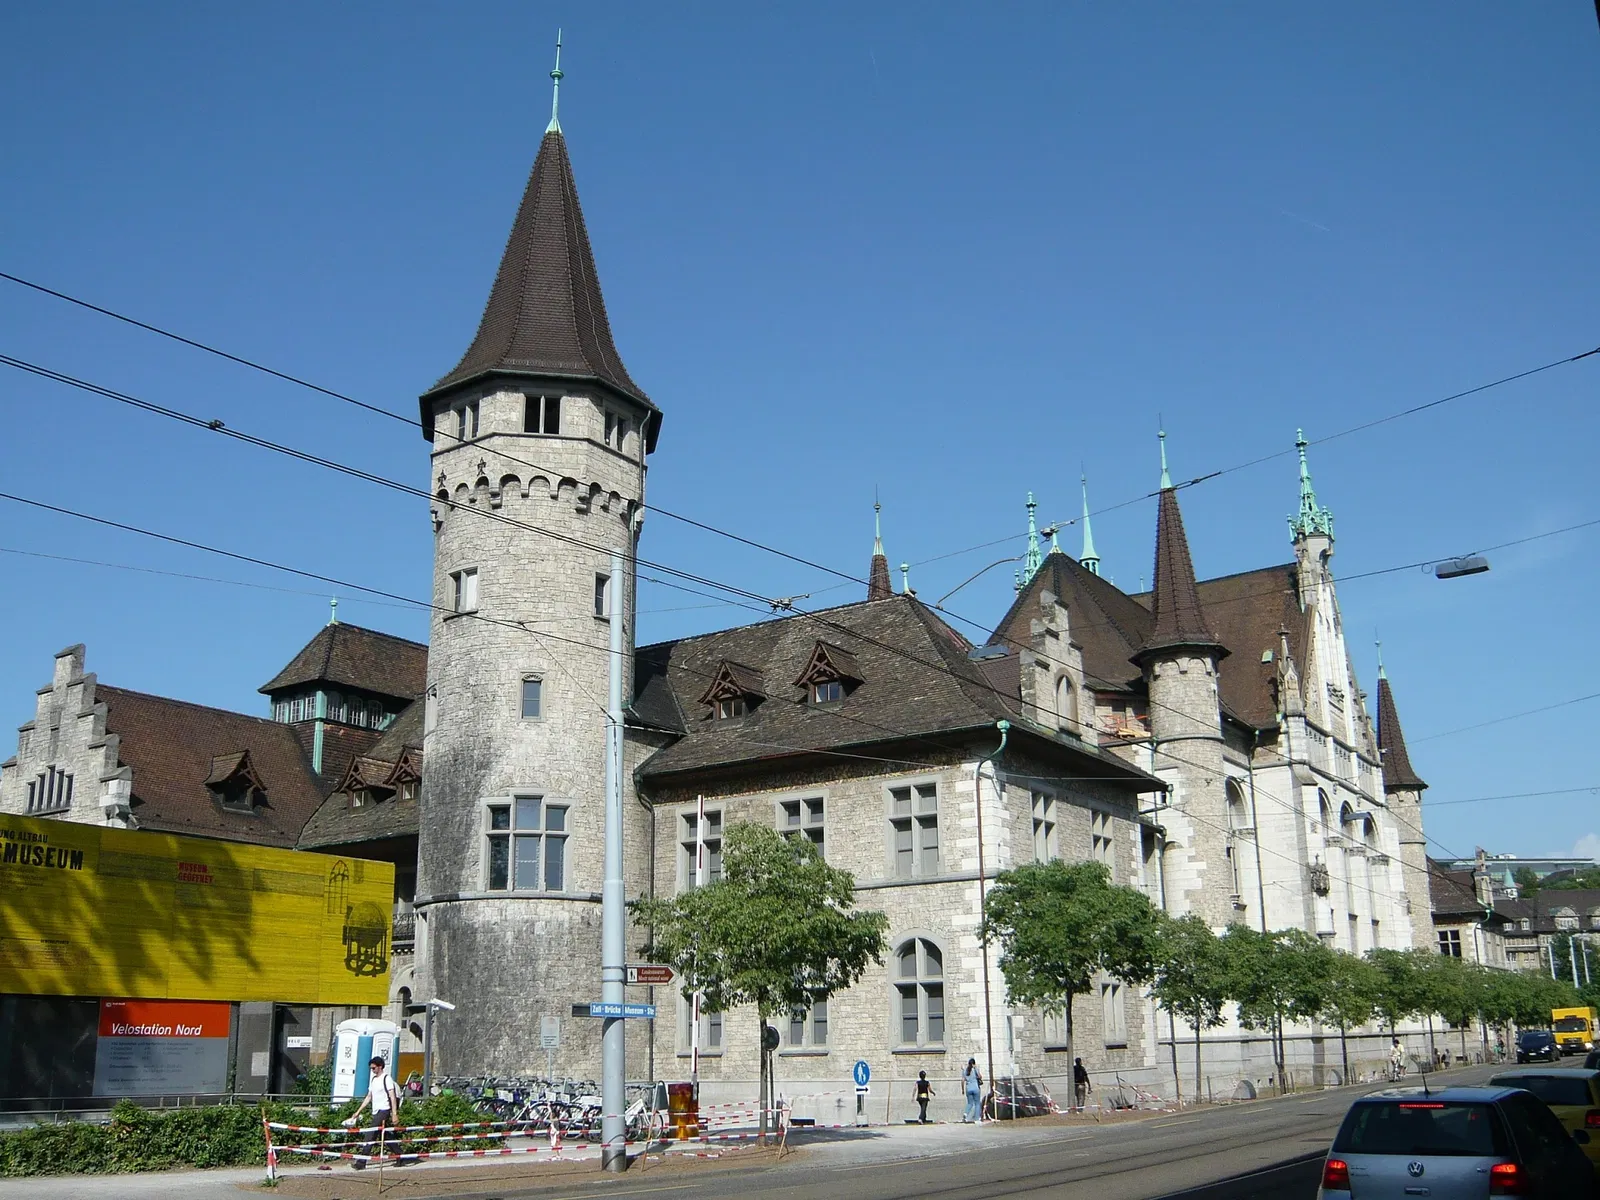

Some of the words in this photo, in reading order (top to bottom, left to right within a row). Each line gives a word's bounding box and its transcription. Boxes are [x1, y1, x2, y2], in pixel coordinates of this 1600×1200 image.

[18, 831, 49, 843] ALTBAU
[178, 862, 208, 873] MUSEUM
[112, 1023, 171, 1036] Velostation
[175, 1024, 203, 1036] Nord
